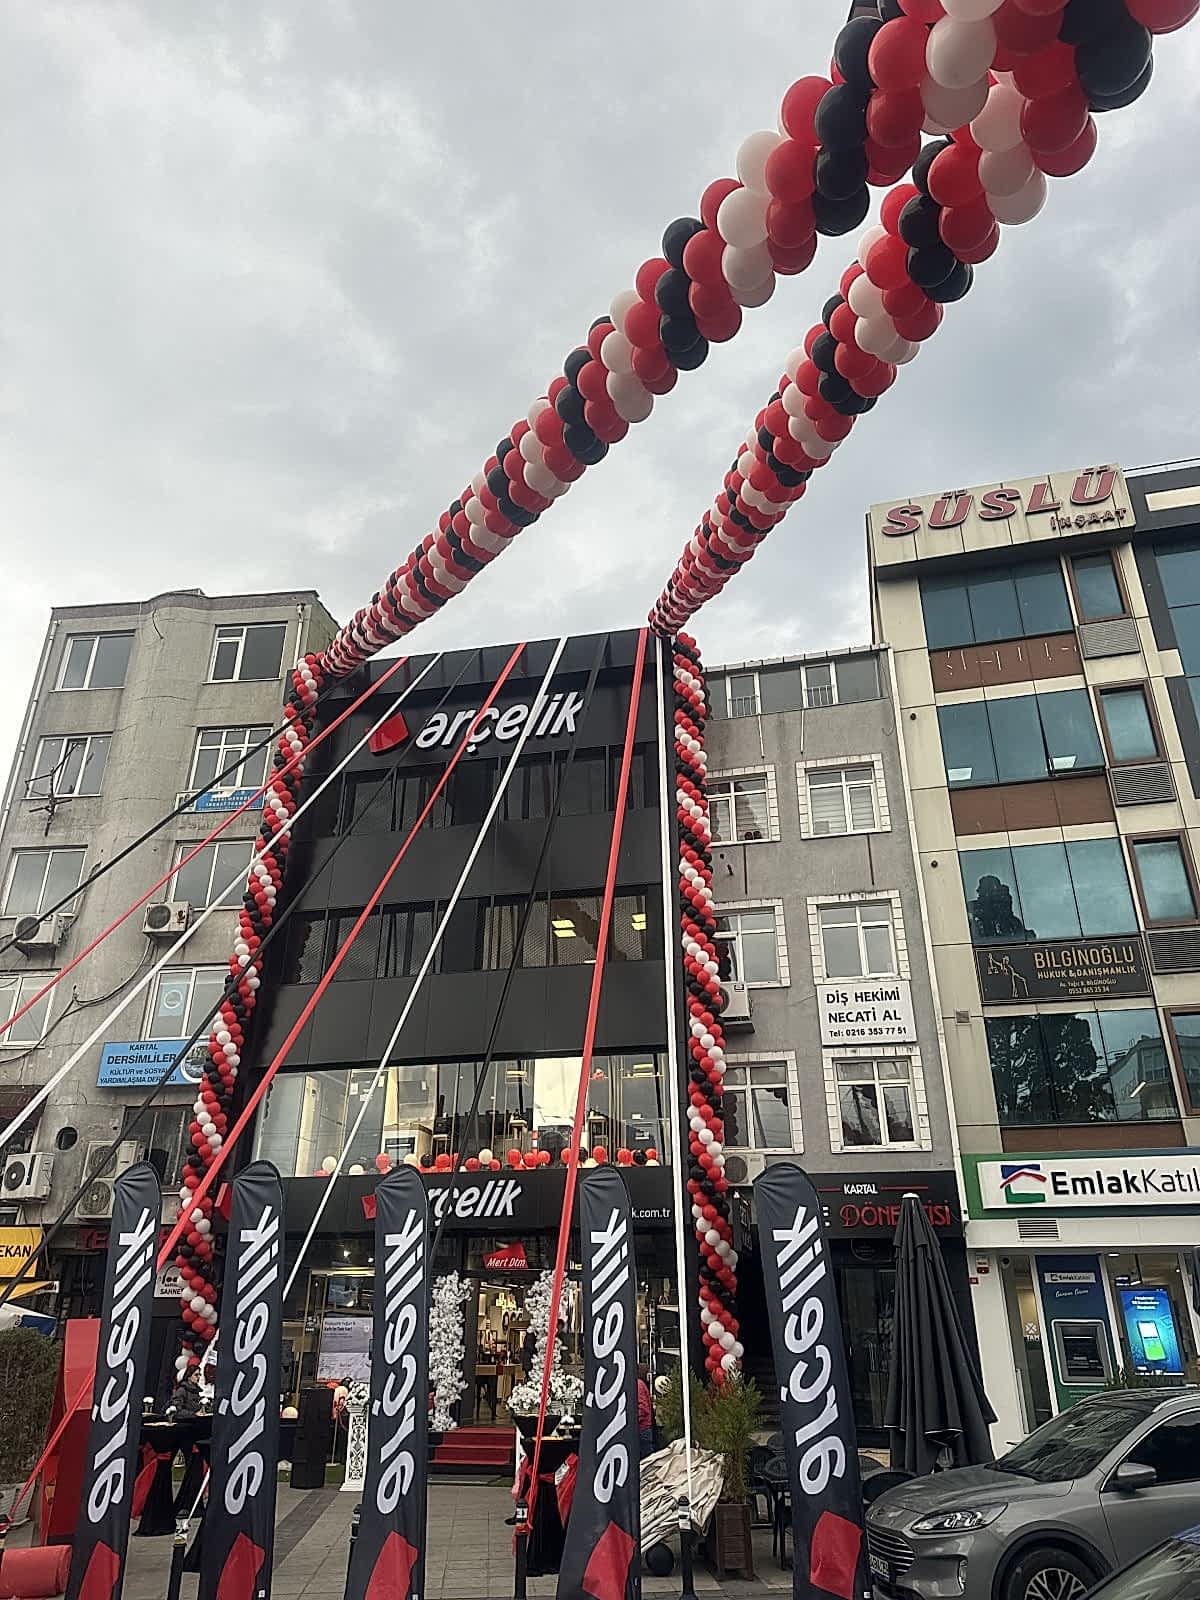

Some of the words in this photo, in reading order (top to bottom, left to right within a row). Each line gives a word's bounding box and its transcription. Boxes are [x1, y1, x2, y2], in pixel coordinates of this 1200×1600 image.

[880, 466, 1119, 537] SÜSLÜ
[415, 692, 585, 752] arçelik
[1033, 945, 1135, 970] BİLGİNOĞLU
[1037, 970, 1067, 979] HUKUK
[1077, 965, 1137, 977] DANIŞMANLIK
[826, 989, 849, 1006] DİŞ
[854, 986, 900, 1003] HEKİMİ
[828, 1006, 877, 1024] NECATİ
[882, 1009, 902, 1021] AL
[829, 1029, 844, 1038] Tel:
[845, 1028, 866, 1037] 0216
[886, 1026, 896, 1035] 77
[129, 1043, 159, 1051] KARTAL
[106, 1052, 177, 1065] DERSİMLİLER
[843, 1183, 879, 1195] KARTAL
[840, 1199, 951, 1228] DÖNEİSİ
[487, 1257, 510, 1268] Mert
